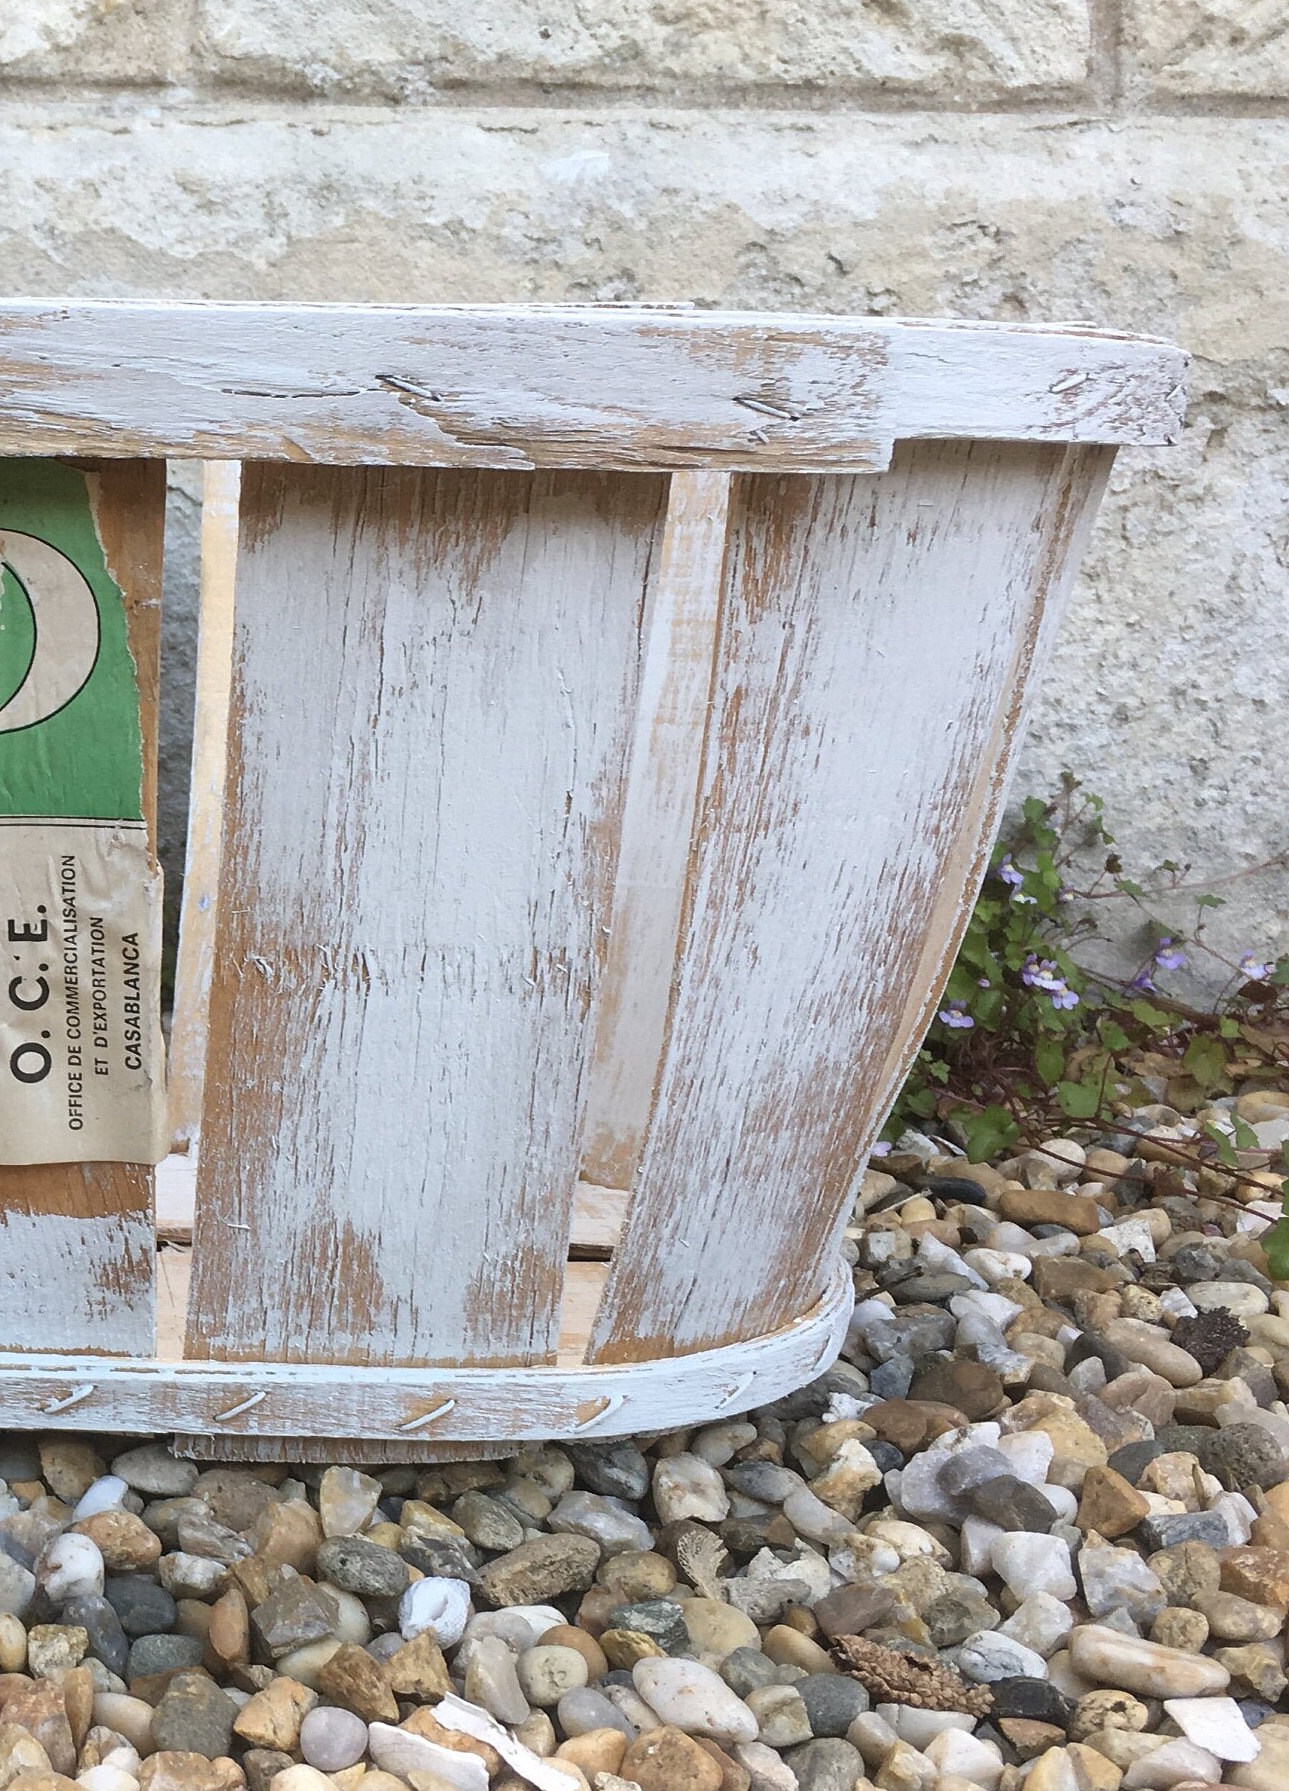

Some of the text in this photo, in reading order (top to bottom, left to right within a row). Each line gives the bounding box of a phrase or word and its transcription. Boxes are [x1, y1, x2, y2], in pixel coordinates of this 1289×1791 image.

[61, 855, 83, 1131] OFFICE DE COMMERCIALISATION
[89, 916, 109, 1076] ET D'EXPORTATION
[122, 932, 142, 1070] CASABLANCA
